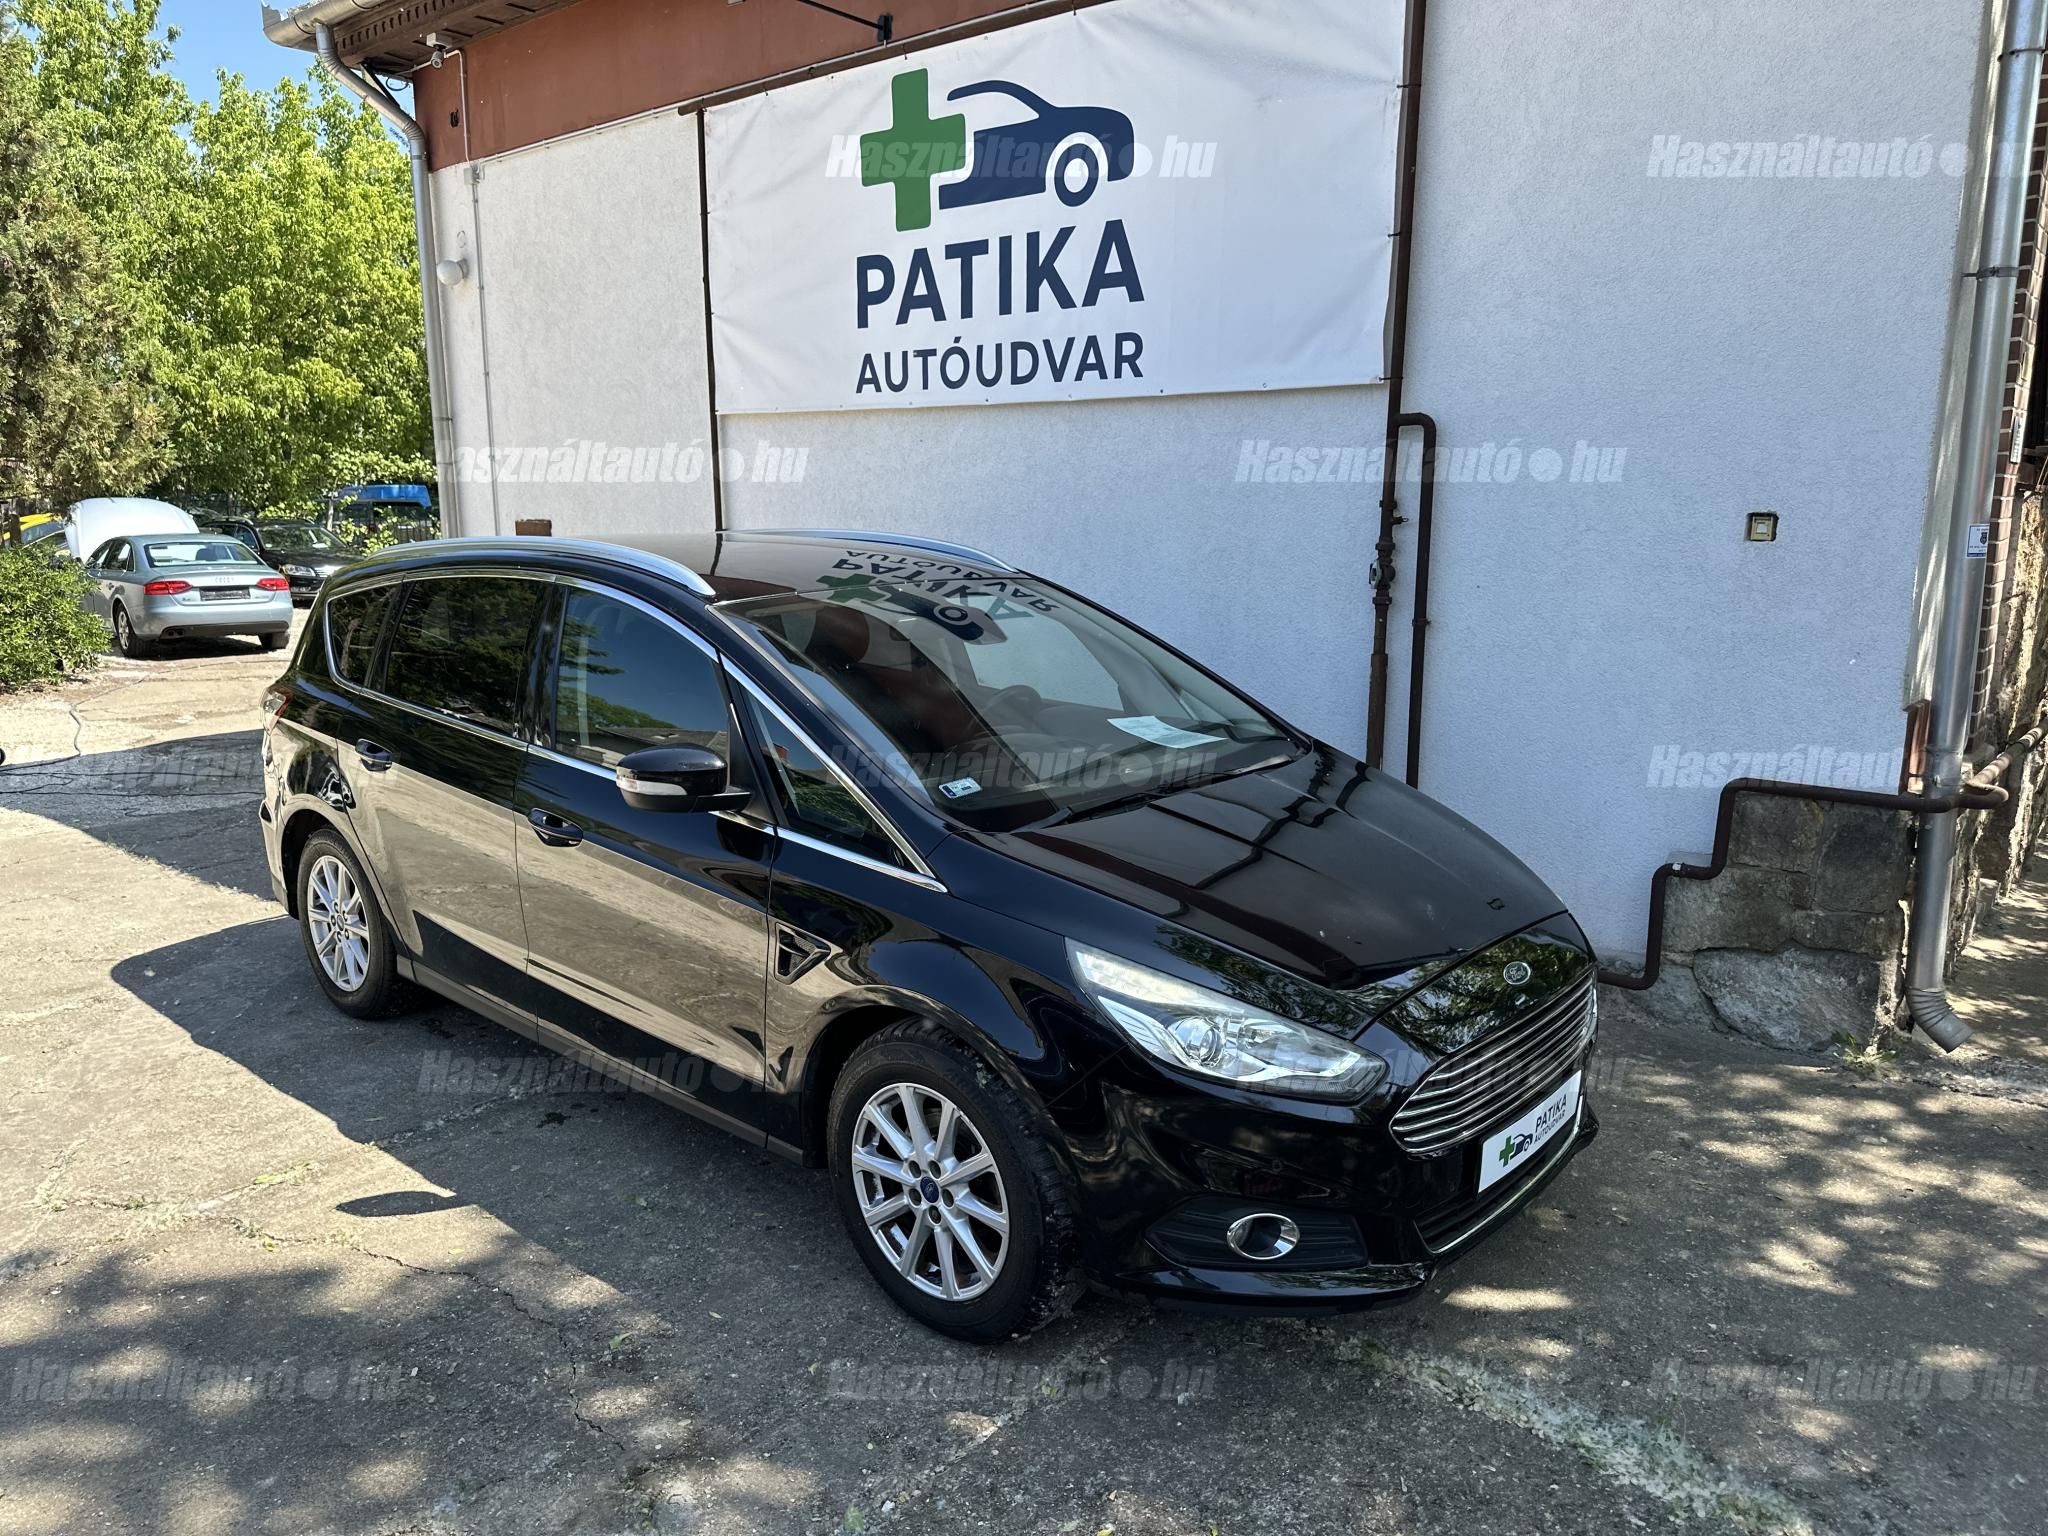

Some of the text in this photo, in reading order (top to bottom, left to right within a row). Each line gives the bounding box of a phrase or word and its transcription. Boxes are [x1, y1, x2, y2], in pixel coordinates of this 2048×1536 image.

[857, 219, 1144, 329] PATIKA
[856, 332, 1144, 394] AUTÓUDVAR
[1535, 1094, 1567, 1132] PATIKA
